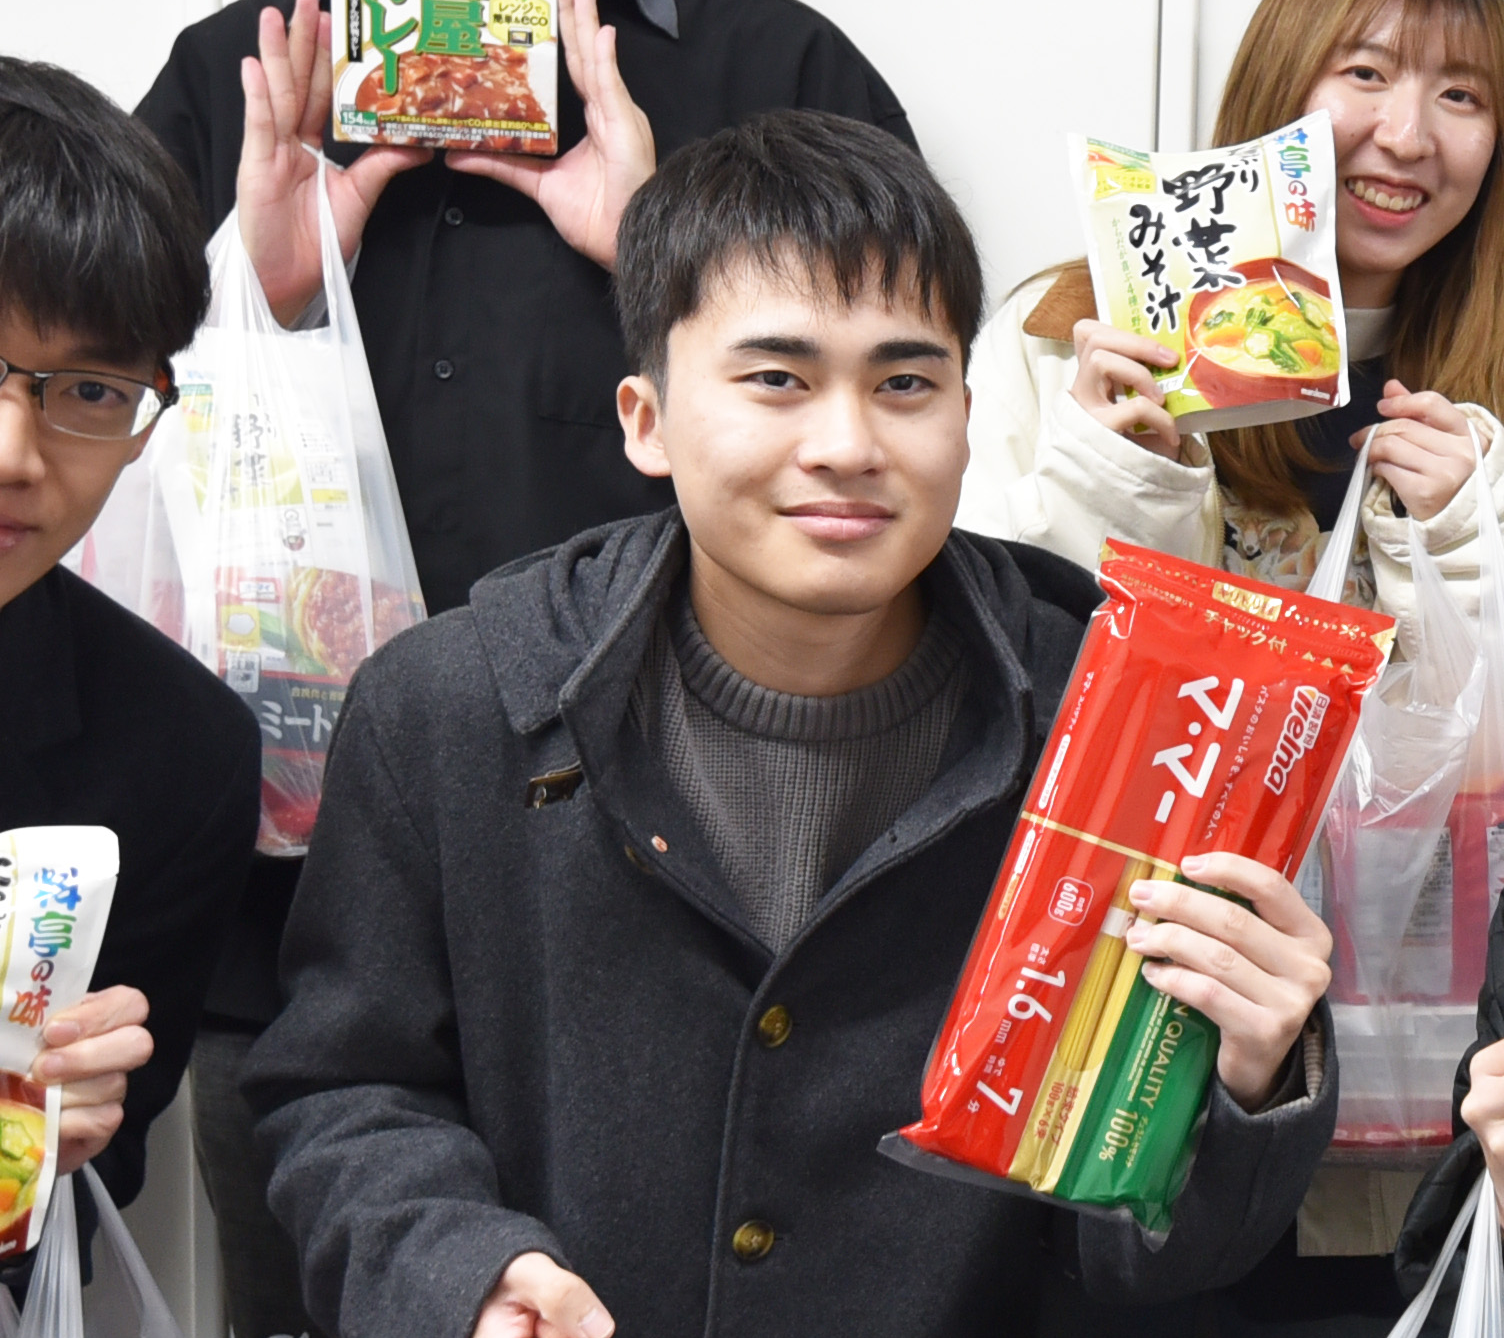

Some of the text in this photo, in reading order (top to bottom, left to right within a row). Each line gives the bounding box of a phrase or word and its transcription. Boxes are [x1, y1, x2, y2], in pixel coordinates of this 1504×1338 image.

[1128, 204, 1182, 331] みそ汁
[1162, 163, 1244, 291] 野菜
[1204, 608, 1288, 655] チャック付
[1152, 675, 1245, 824] マ・マー
[1264, 686, 1320, 794] Welna
[7, 867, 83, 1029] 料亭の味
[1053, 881, 1079, 917] 600g
[1140, 1019, 1185, 1111] QUALITY
[1098, 1108, 1139, 1162] 100%
